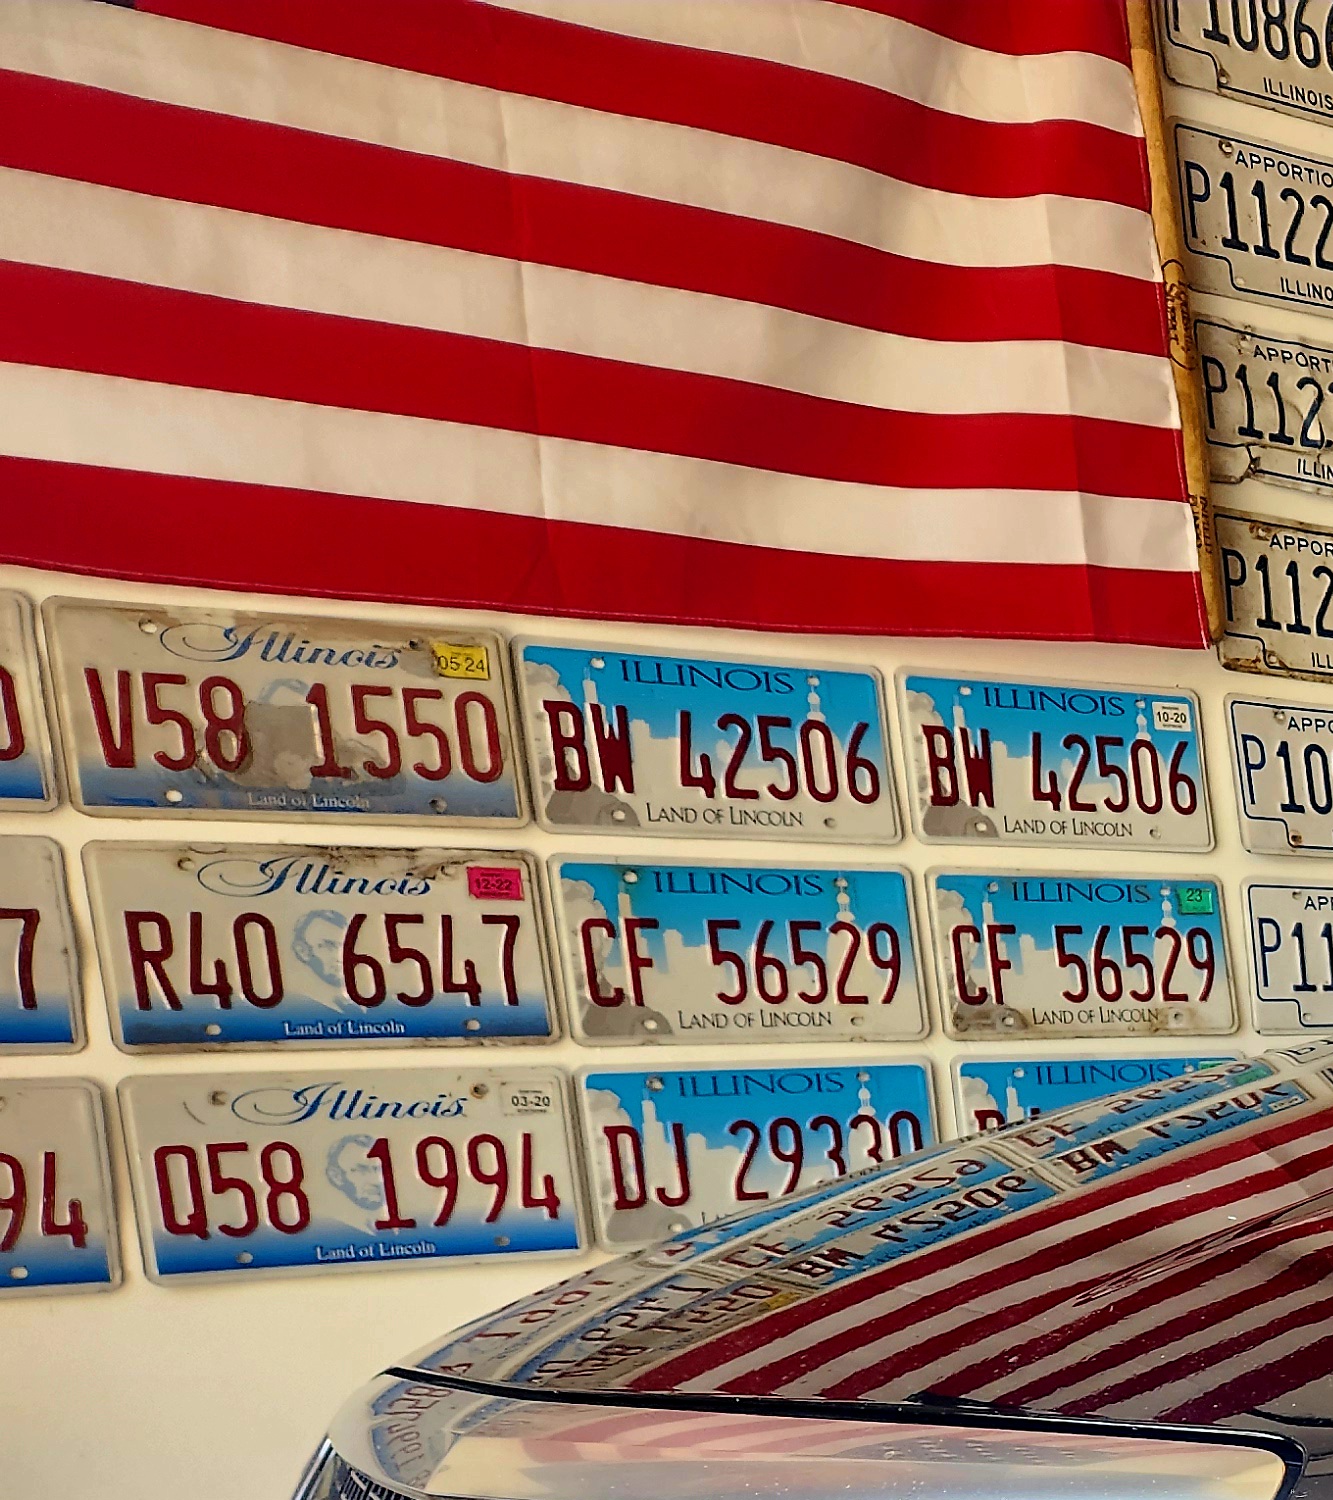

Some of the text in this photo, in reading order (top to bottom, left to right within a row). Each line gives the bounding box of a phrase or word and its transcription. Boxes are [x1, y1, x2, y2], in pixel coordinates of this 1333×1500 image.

[1264, 77, 1333, 111] ILLINOIS
[159, 622, 399, 669] Illinois
[619, 660, 795, 694] ILLINOIS
[983, 687, 1125, 716] ILLINOIS
[84, 667, 252, 773] V58
[306, 682, 503, 783] 1550
[1156, 710, 1186, 724] 10-20
[543, 700, 880, 804] BW 42506
[921, 724, 1197, 815] BW 42506
[647, 803, 804, 827] LAND OF LINCOLN
[1003, 816, 1133, 837] LAND OF LINCOLN
[197, 857, 436, 897] Illinois
[653, 871, 824, 896] ILLINOIS
[1012, 882, 1152, 903] ILLINOIS
[1186, 888, 1203, 902] 23
[124, 910, 521, 1010] R40 6547
[581, 918, 901, 1008] CF 56529
[951, 924, 1215, 1005] CF 56529
[284, 1020, 405, 1035] Land of Lincoln
[679, 1009, 832, 1029] LAND OF LINCOLN
[1032, 1006, 1159, 1025] LAND OF LINCOLN
[678, 1072, 845, 1098] ILLINOIS
[1036, 1063, 1175, 1085] ILLINOIS
[232, 1081, 468, 1126] Illinois
[511, 1095, 551, 1107] 03-20
[603, 1122, 690, 1210] DJ
[154, 1133, 561, 1240] Q58 1994
[316, 1241, 436, 1260] Land of Lincoln
